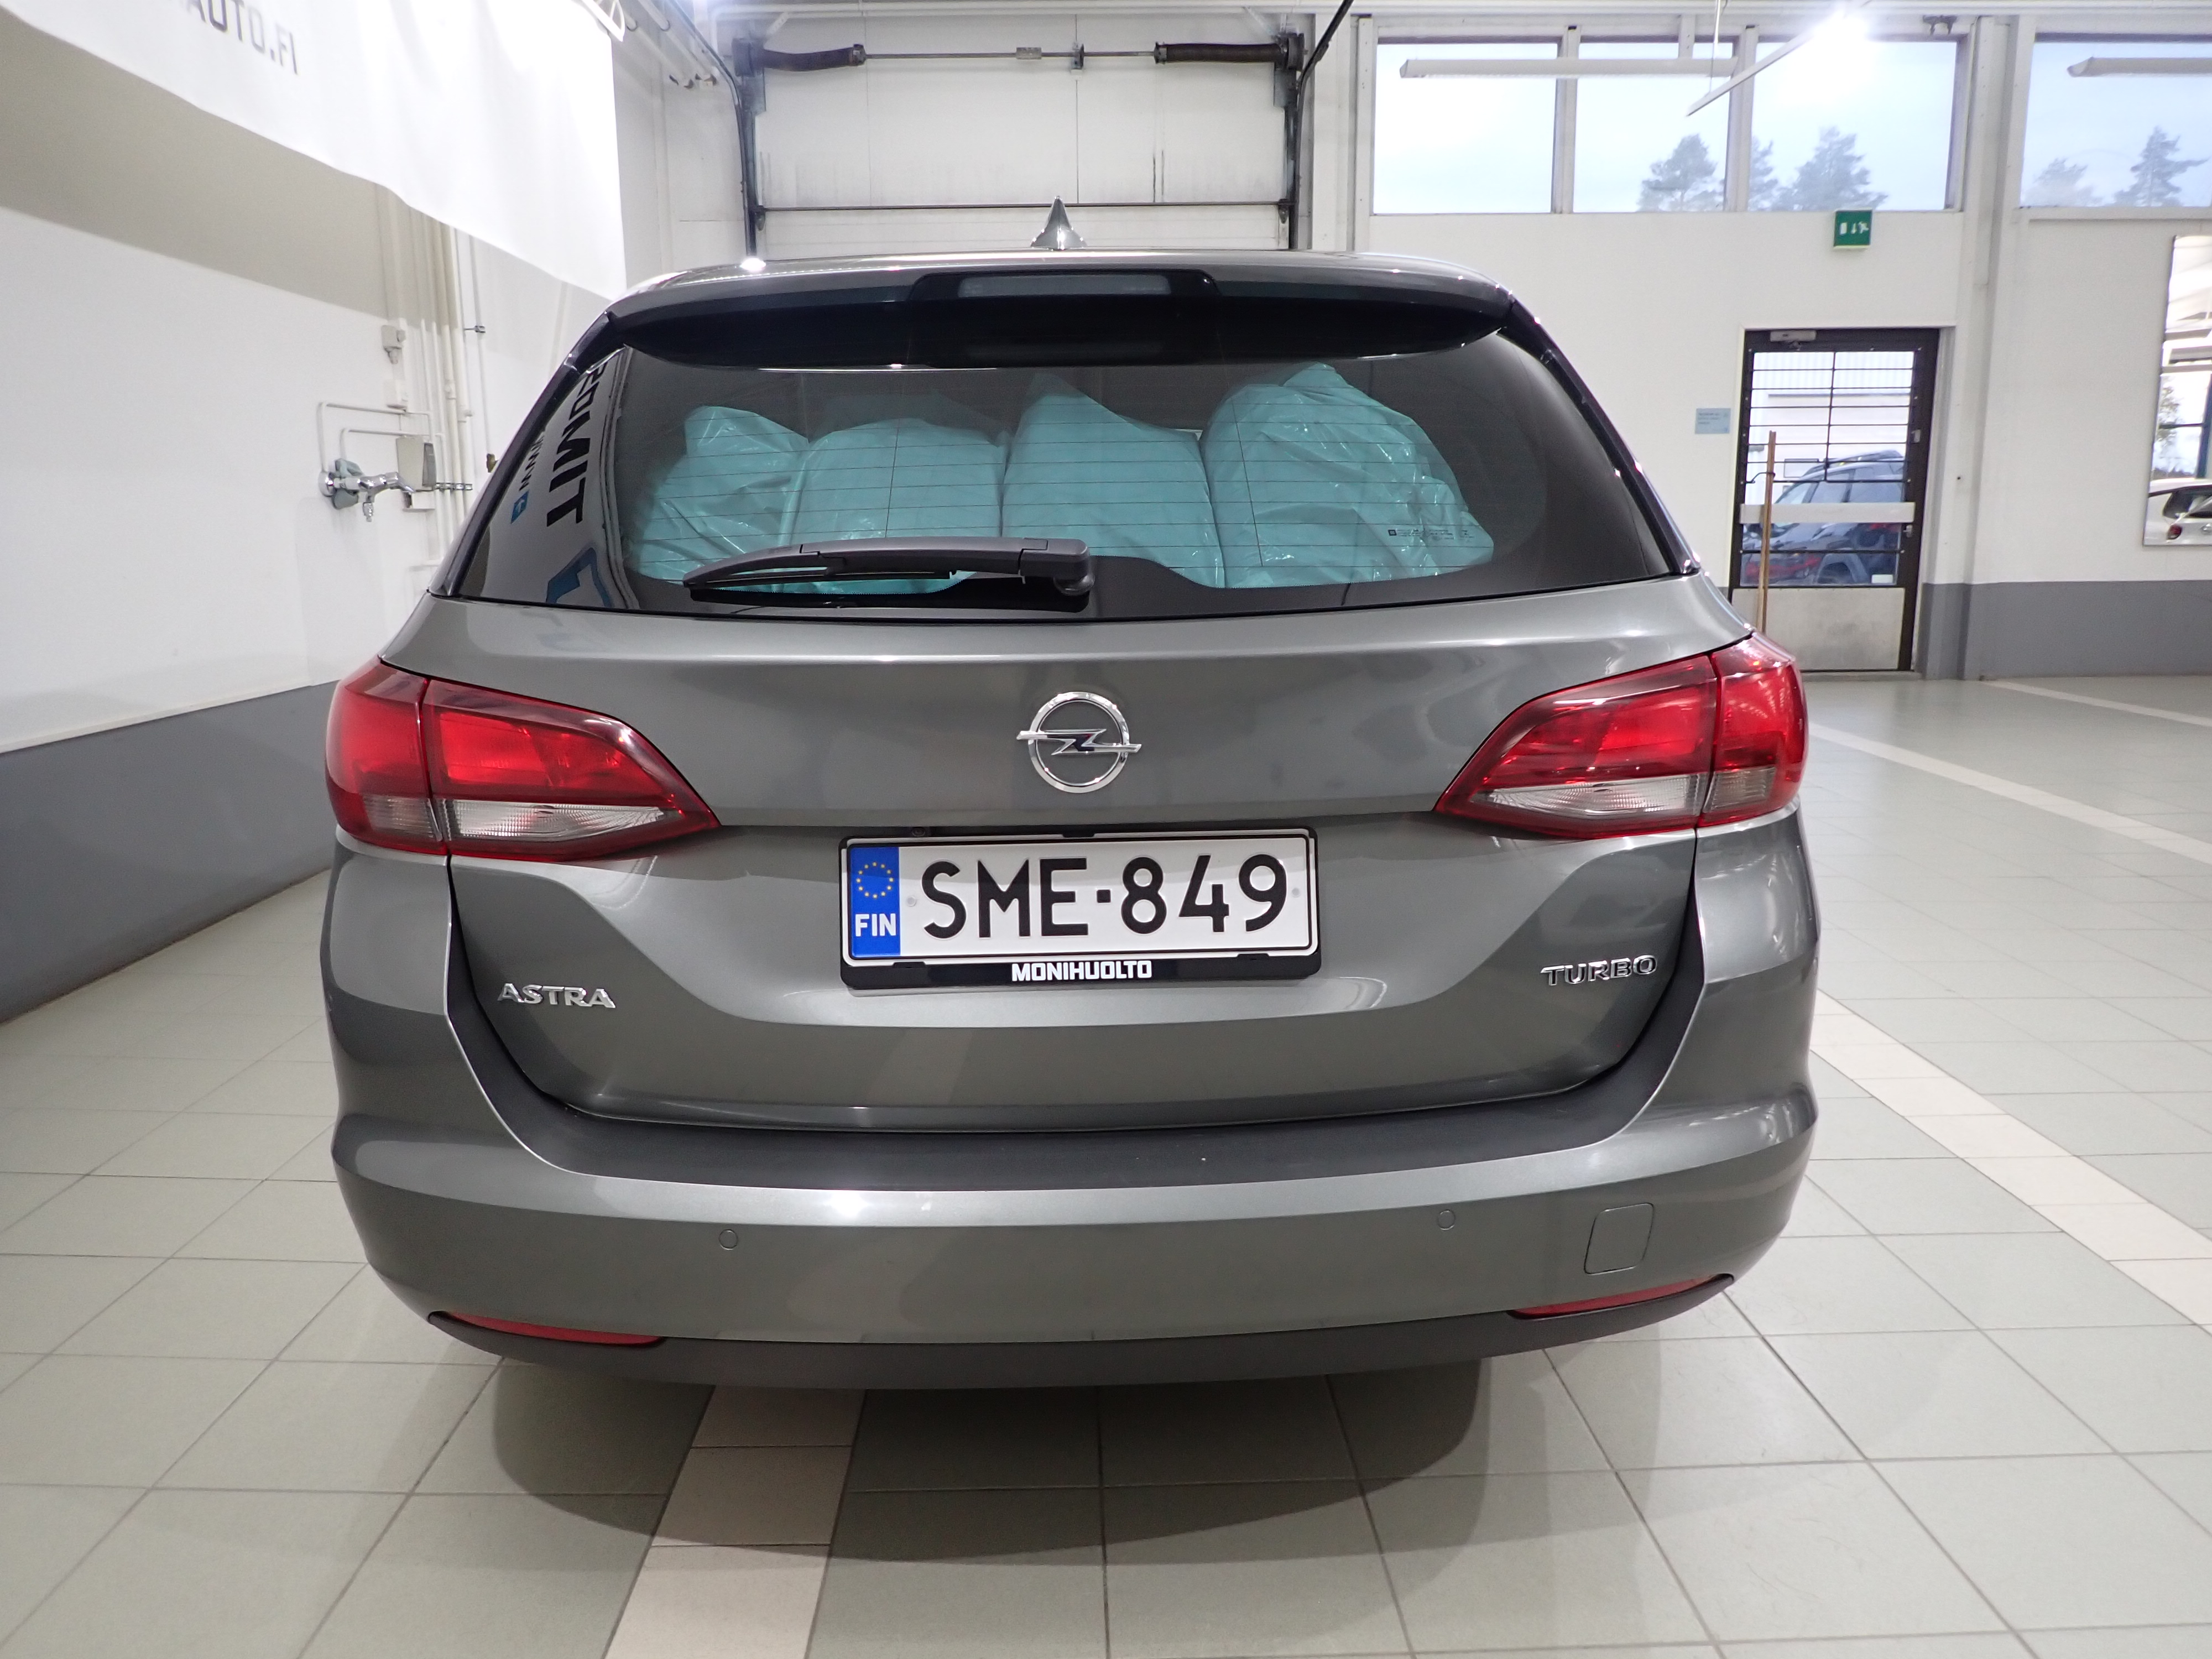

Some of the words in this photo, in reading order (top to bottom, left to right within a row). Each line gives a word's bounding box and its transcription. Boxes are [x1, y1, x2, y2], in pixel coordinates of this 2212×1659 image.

[854, 913, 896, 937] FIN
[1011, 960, 1152, 982] MONIHUOLTO
[1540, 954, 1658, 986] TURBO
[497, 983, 617, 1009] ASTRA
